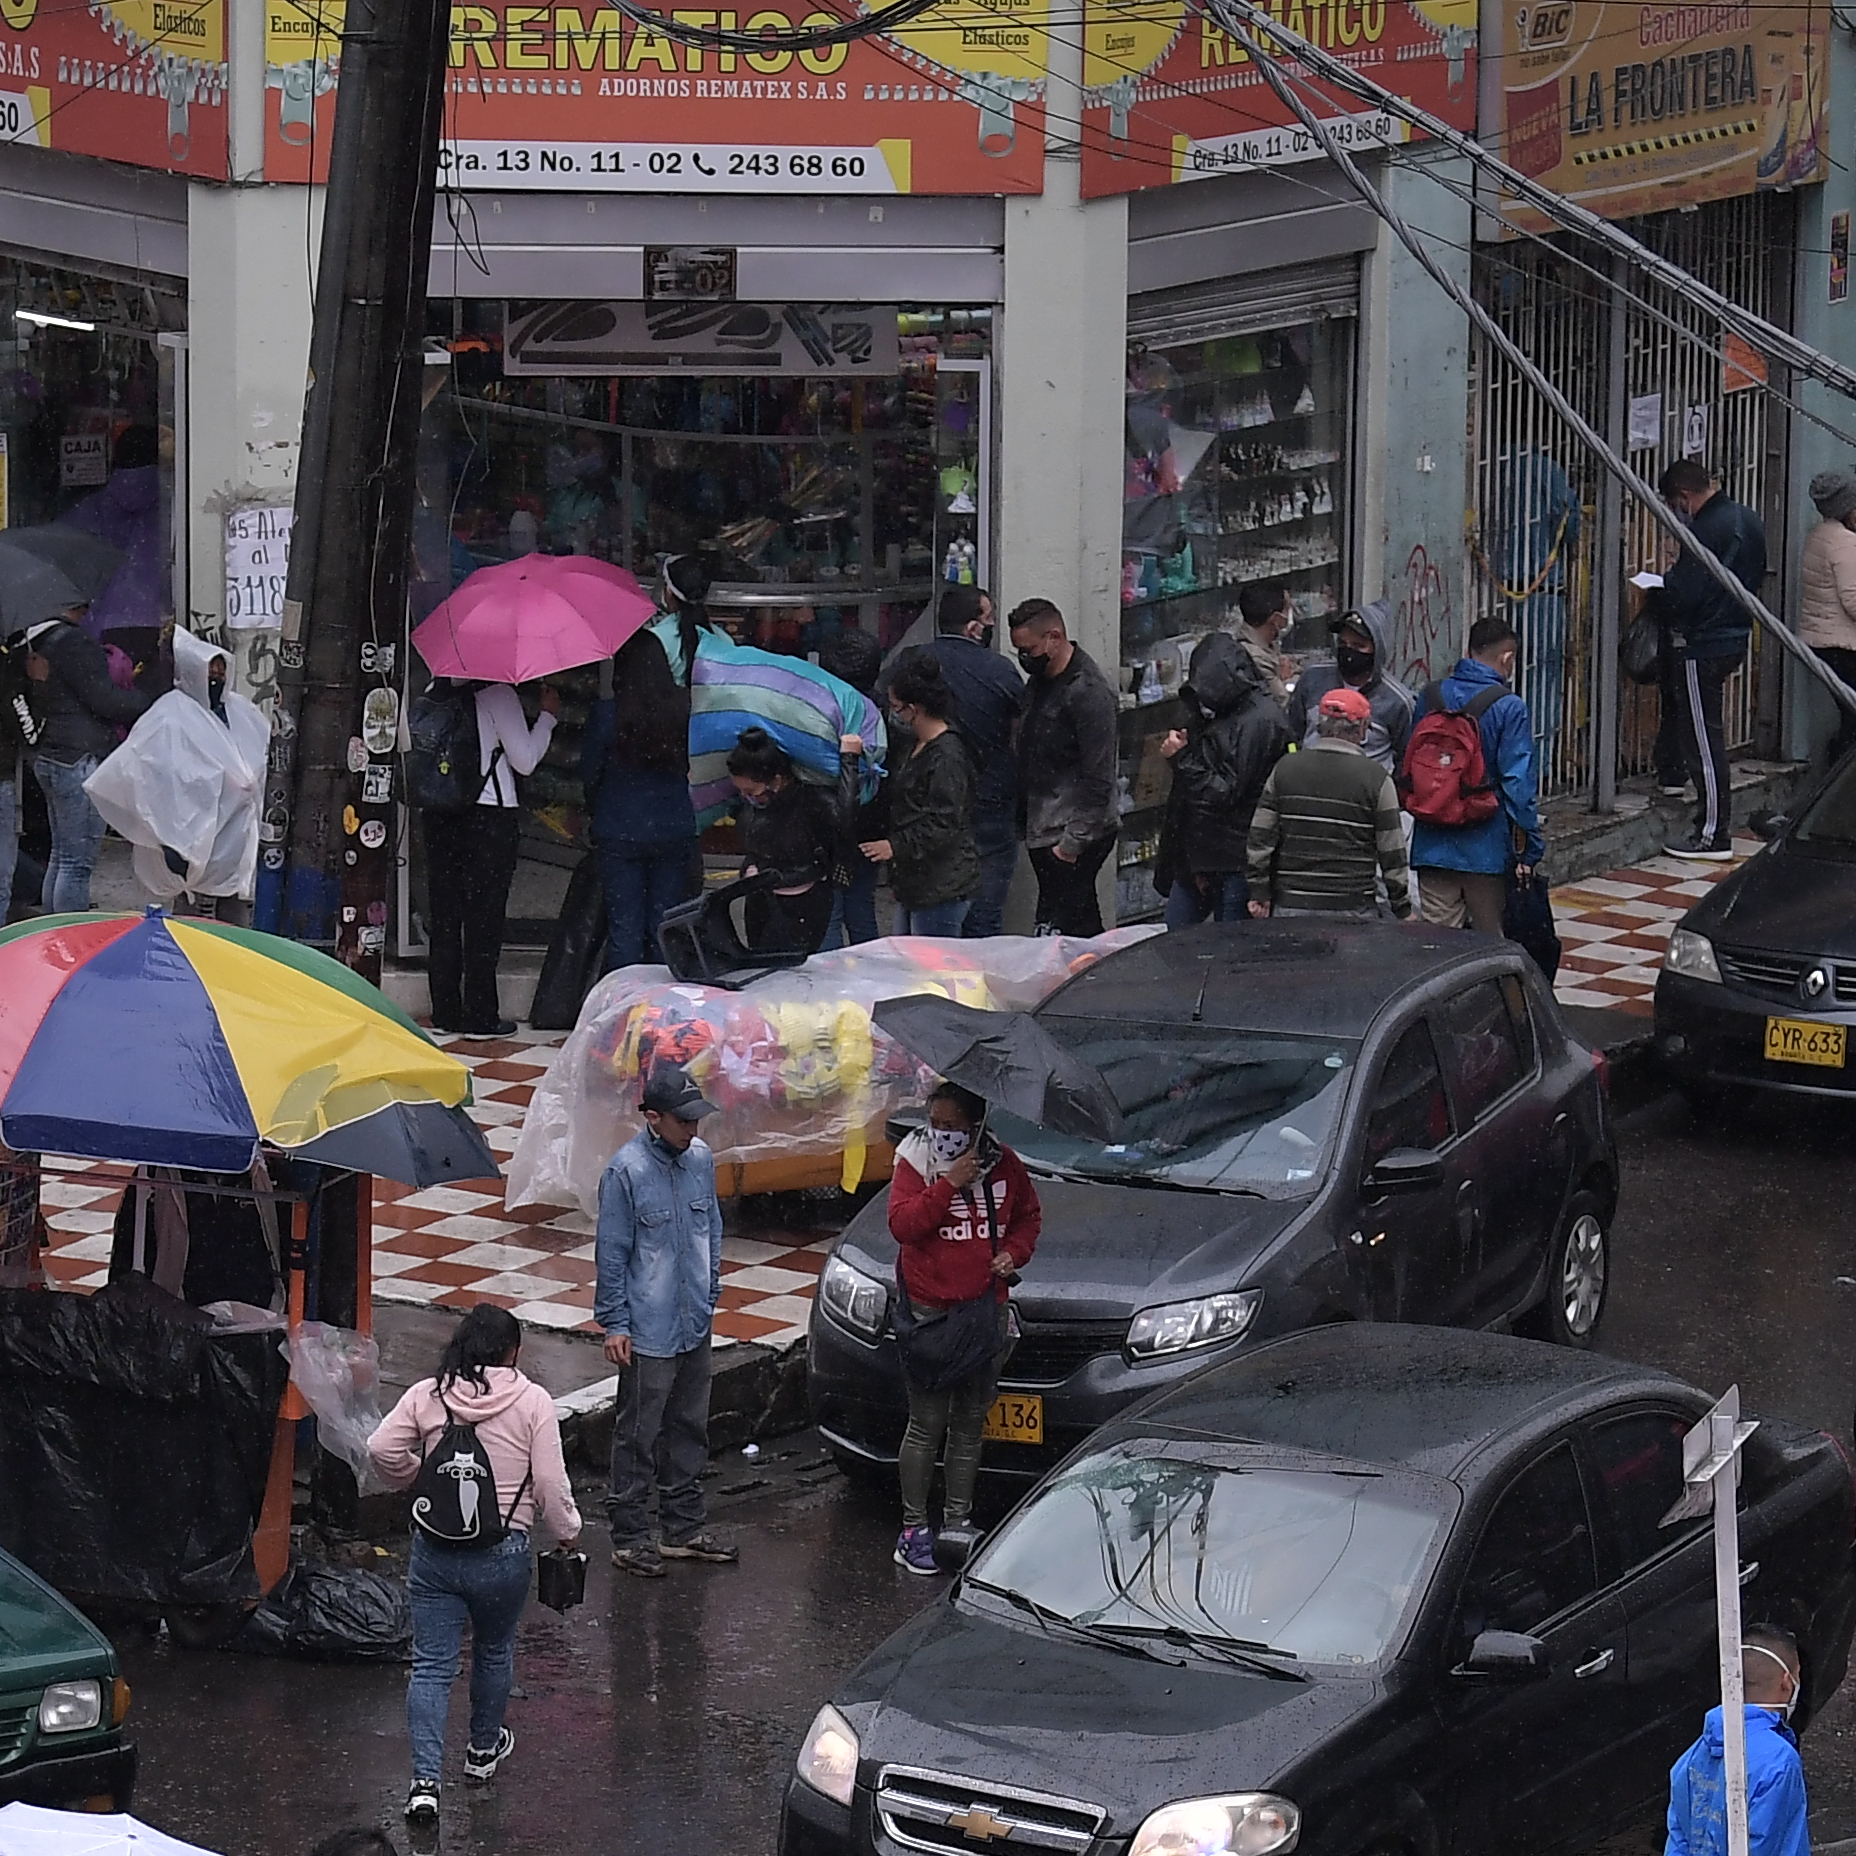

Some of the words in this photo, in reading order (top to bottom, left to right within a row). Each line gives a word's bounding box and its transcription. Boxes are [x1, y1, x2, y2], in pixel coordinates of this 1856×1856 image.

[447, 5, 849, 74] REMATICO
[598, 77, 691, 98] ADORNOS
[695, 79, 793, 100] REMATEX
[797, 81, 848, 101] S.A.S
[1568, 70, 1605, 136] LA
[1612, 43, 1758, 128] FRONTERA
[1242, 140, 1262, 161] No.
[1266, 134, 1282, 158] 11
[1375, 116, 1391, 137] 60
[496, 149, 531, 172] 13
[540, 150, 581, 174] No.
[590, 151, 626, 174] 11
[648, 152, 683, 175] 02
[728, 153, 779, 176] 243
[789, 154, 824, 177] 68
[831, 154, 866, 178] 60
[63, 440, 101, 455] CAJA
[939, 1219, 1006, 1240] adids
